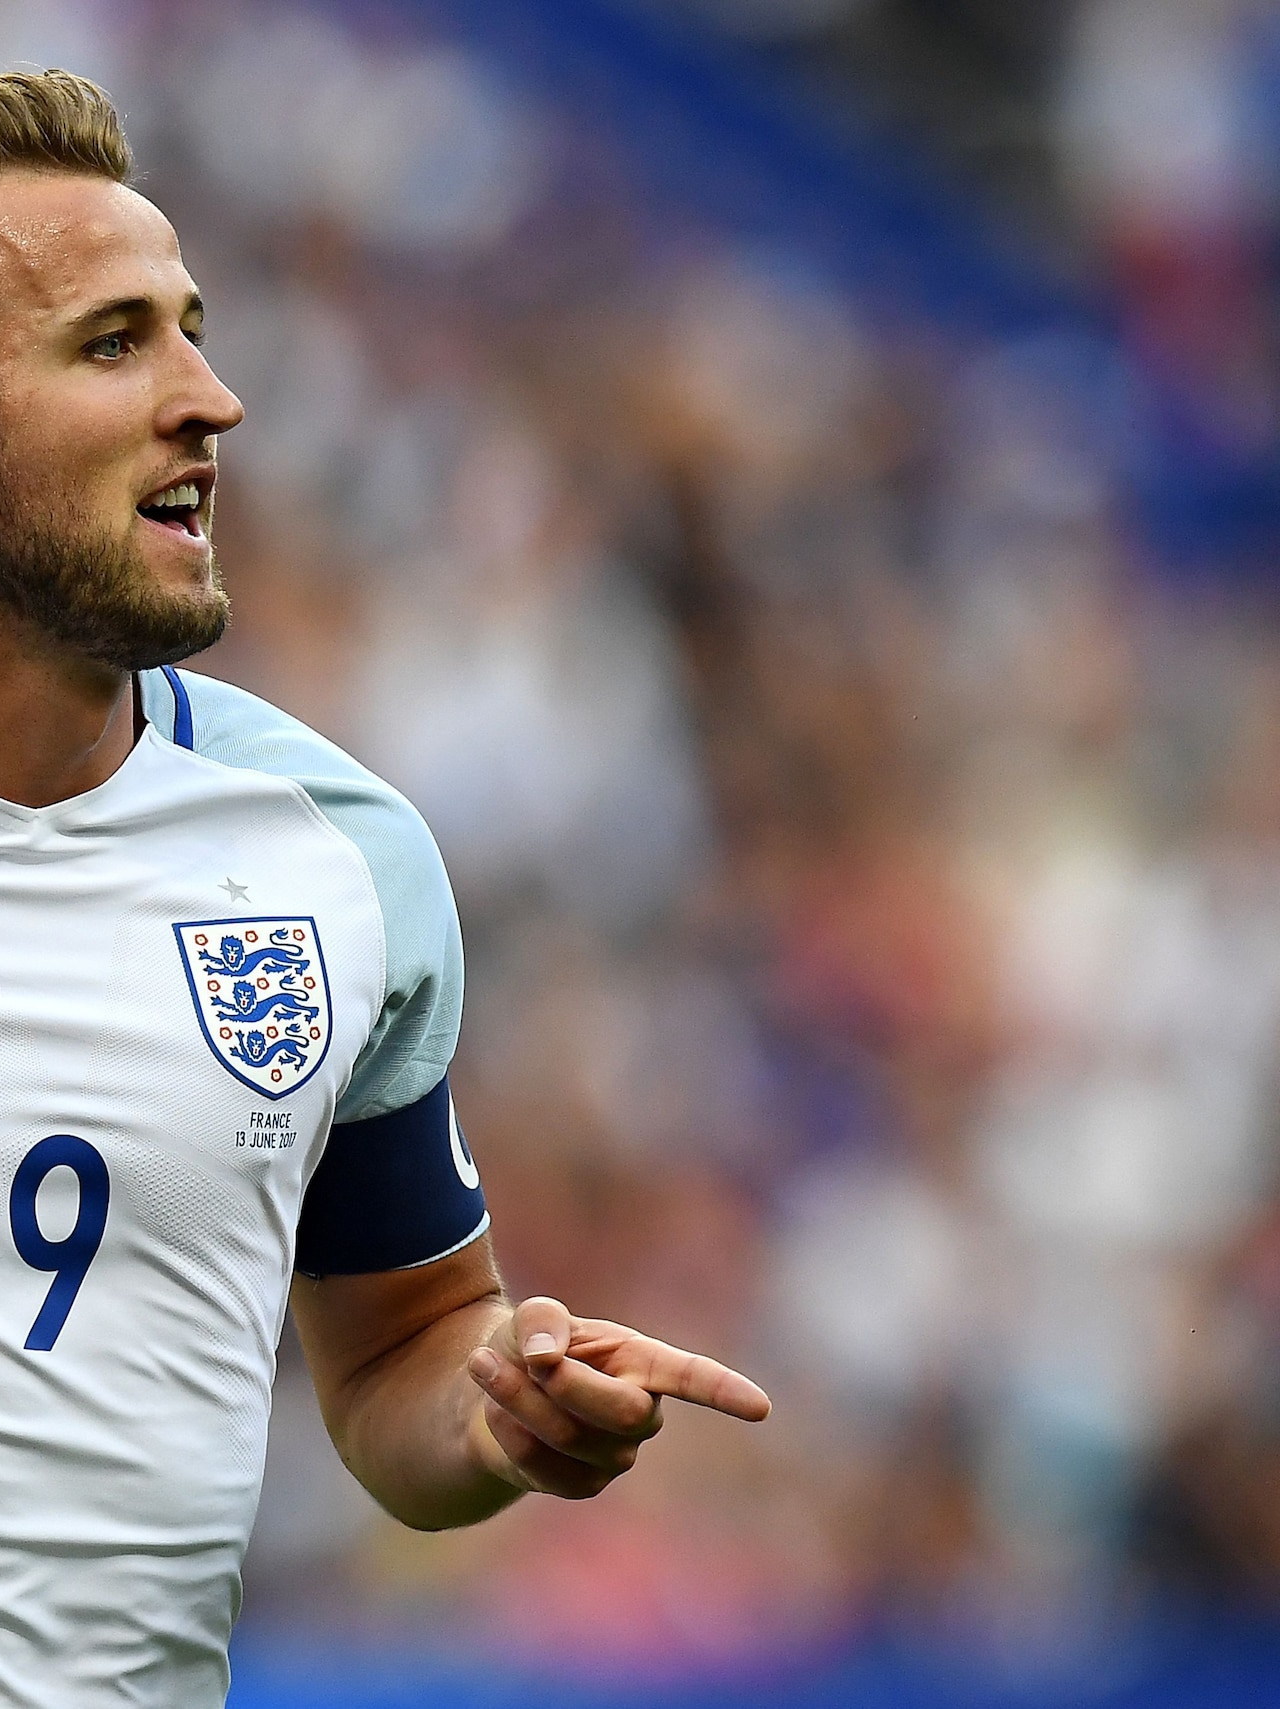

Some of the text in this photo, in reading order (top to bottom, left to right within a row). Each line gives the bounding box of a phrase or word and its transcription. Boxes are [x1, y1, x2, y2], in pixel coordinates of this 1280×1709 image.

[249, 1112, 292, 1129] FRANCE
[235, 1131, 246, 1147] 13
[249, 1132, 277, 1149] JUNE
[9, 1134, 110, 1351] 9
